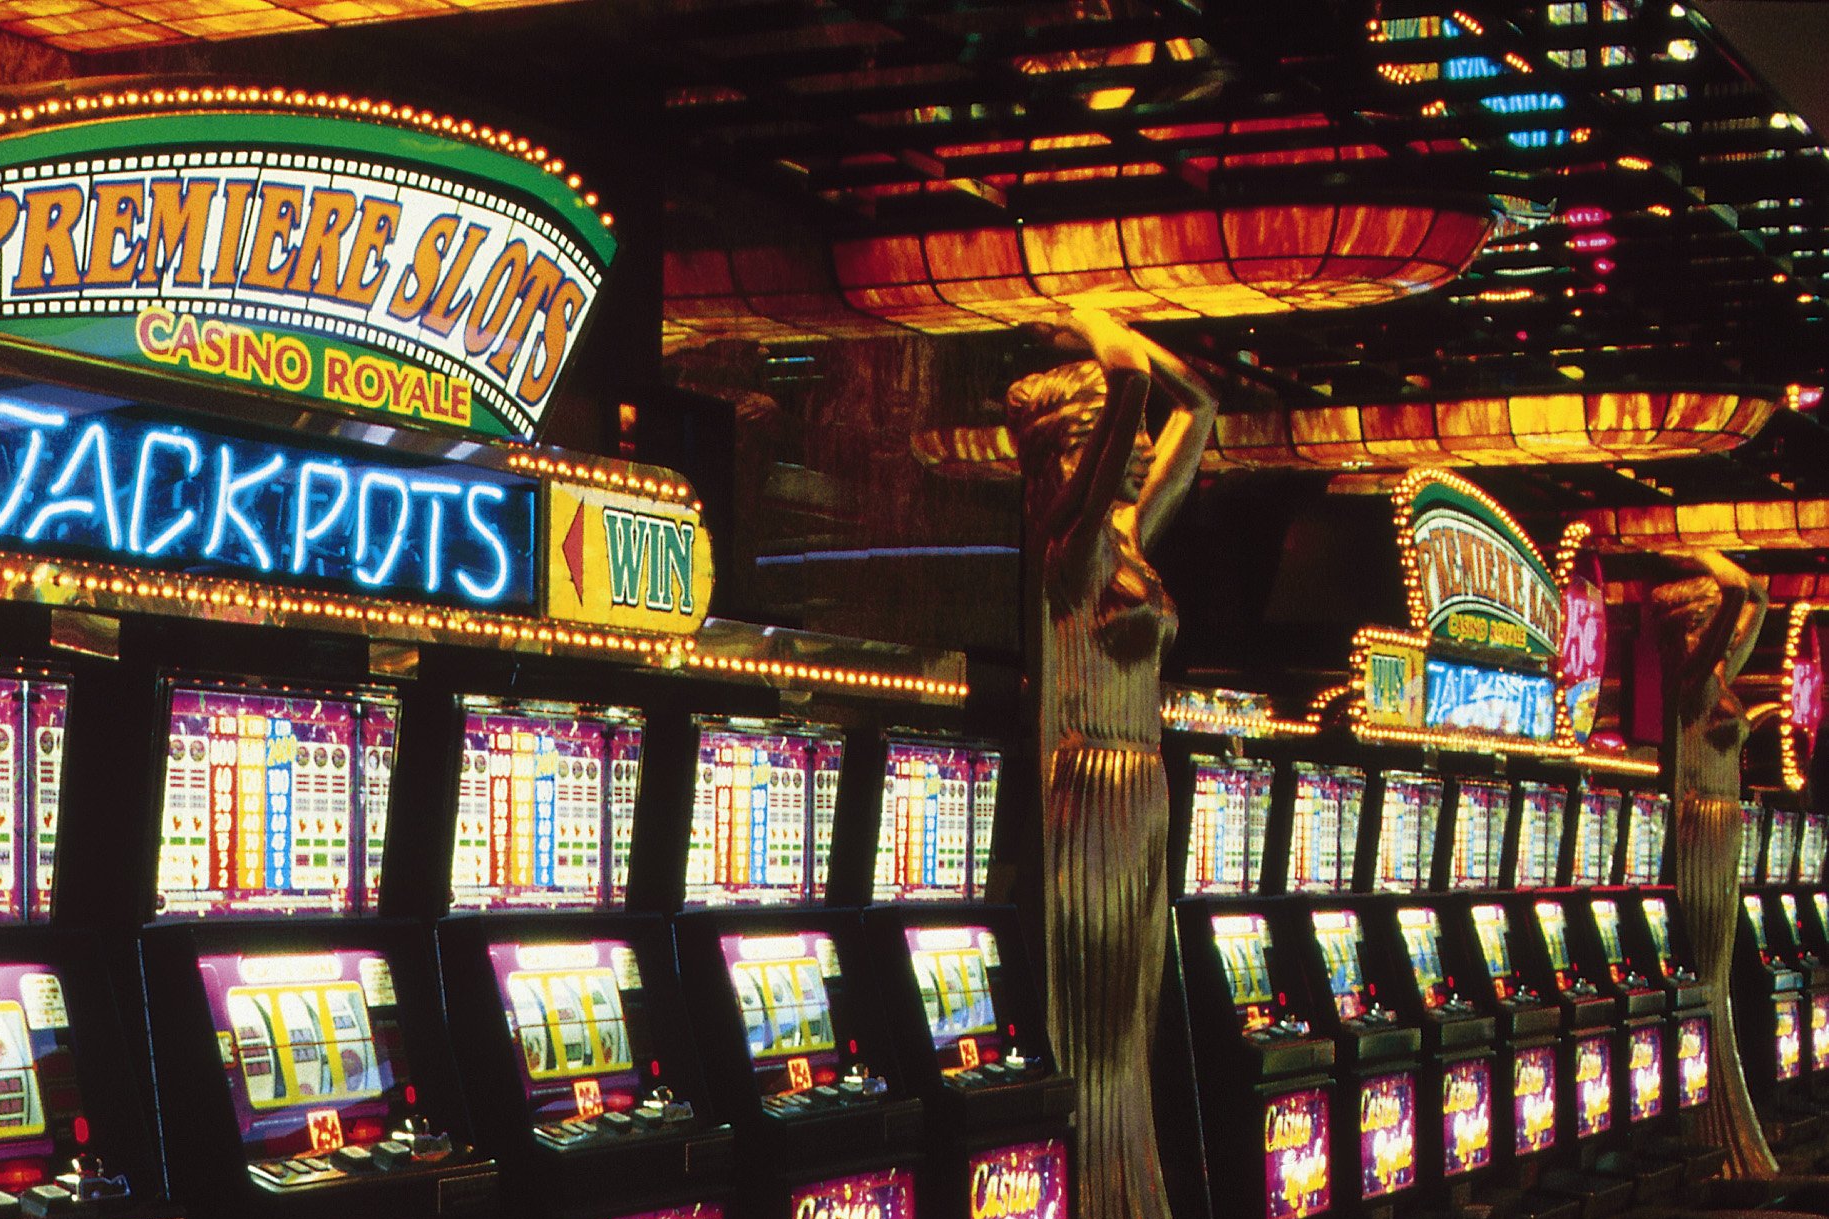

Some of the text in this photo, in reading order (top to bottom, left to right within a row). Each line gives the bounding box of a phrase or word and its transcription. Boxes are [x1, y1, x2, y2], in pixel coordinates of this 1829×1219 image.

[387, 213, 589, 408] SLOTS
[136, 306, 473, 427] CASINO ROYALE
[602, 509, 694, 614] WIN
[1447, 614, 1488, 641] CASINO
[1371, 654, 1406, 713] WIN
